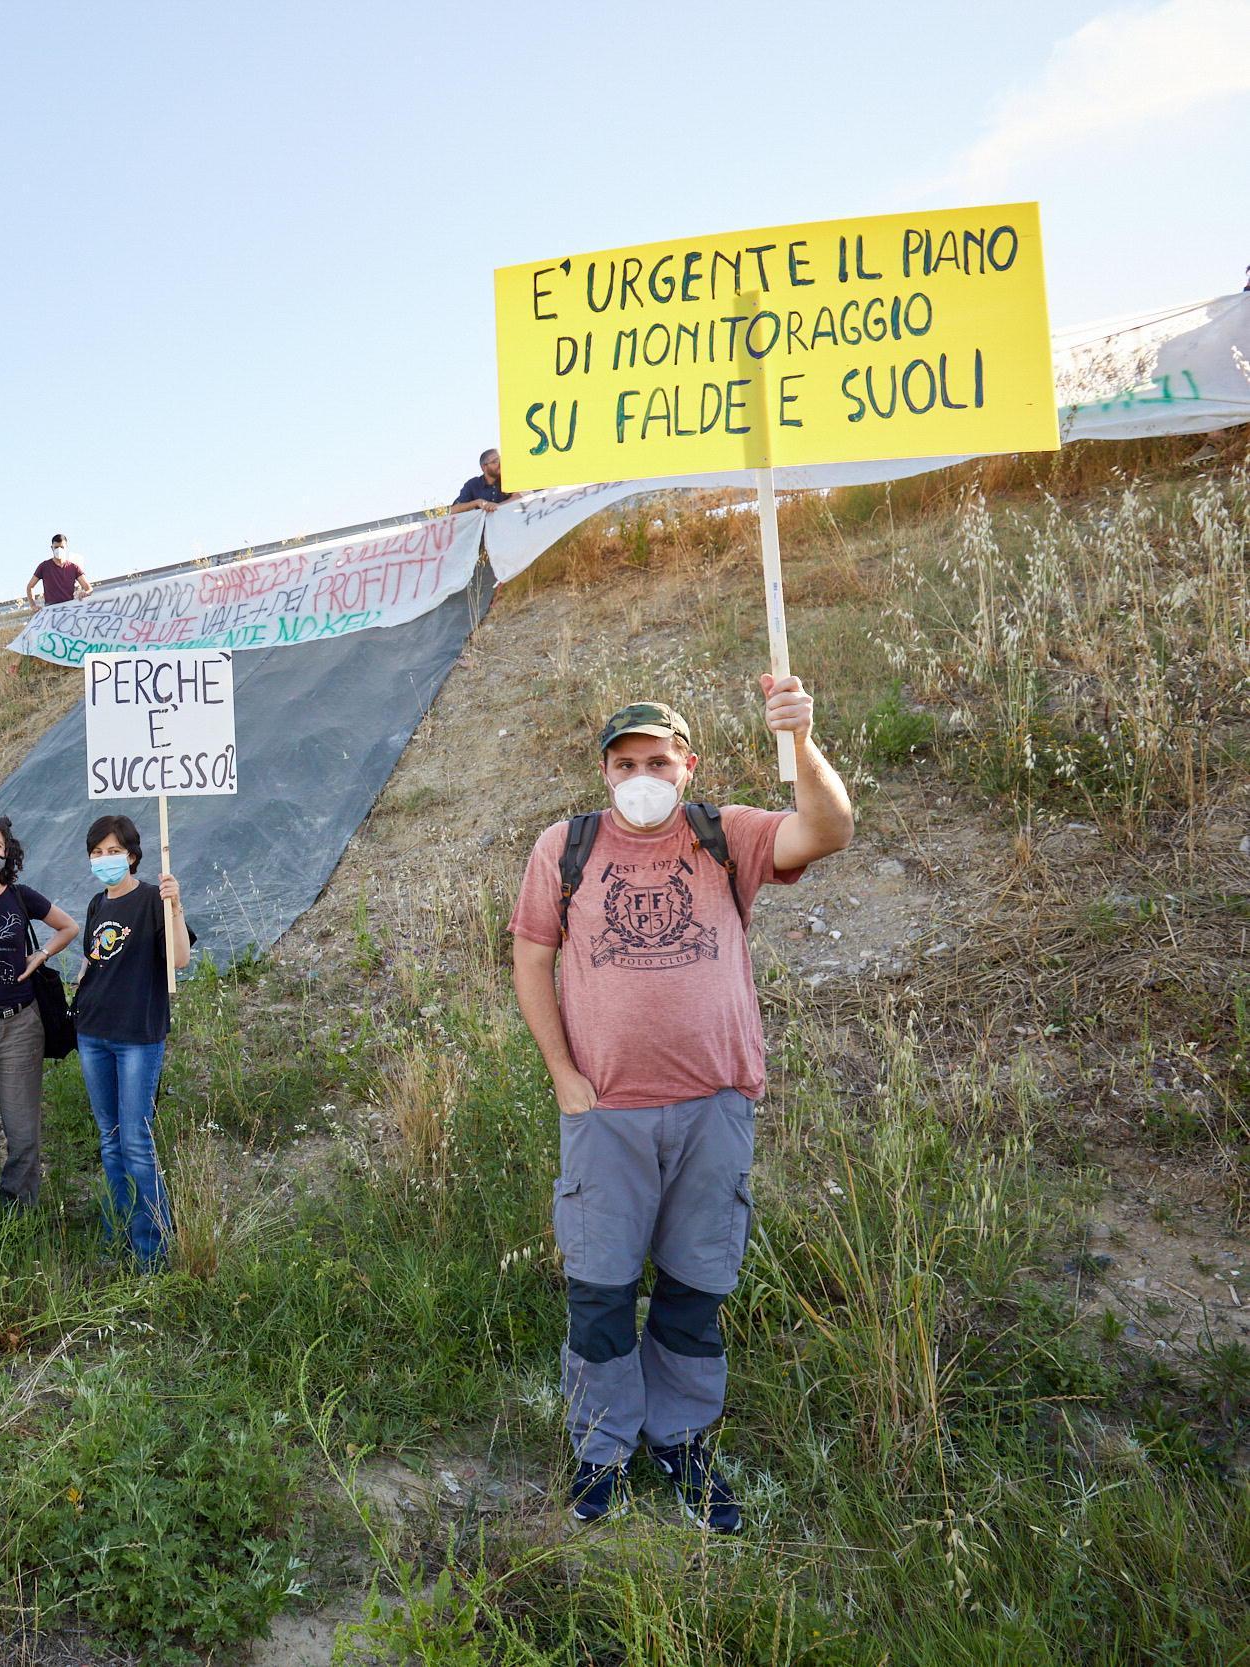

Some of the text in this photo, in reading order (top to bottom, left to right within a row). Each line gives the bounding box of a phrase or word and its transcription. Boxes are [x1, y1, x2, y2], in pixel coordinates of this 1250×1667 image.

[586, 240, 815, 313] URGENTE
[838, 234, 883, 283] IL
[902, 225, 1019, 278] PIANO
[555, 292, 933, 376] DI MONITORAGGIO
[525, 348, 984, 456] SU FALDE E SUOLI
[50, 613, 123, 640] NOSTRA
[121, 616, 199, 644] SALUTE
[267, 583, 309, 618] DEI
[312, 554, 446, 614] PROFITTI
[91, 743, 236, 794] SUCCESSO?
[615, 863, 638, 874] EST
[651, 859, 680, 872] 1972
[619, 954, 692, 966] POLO CLUB
